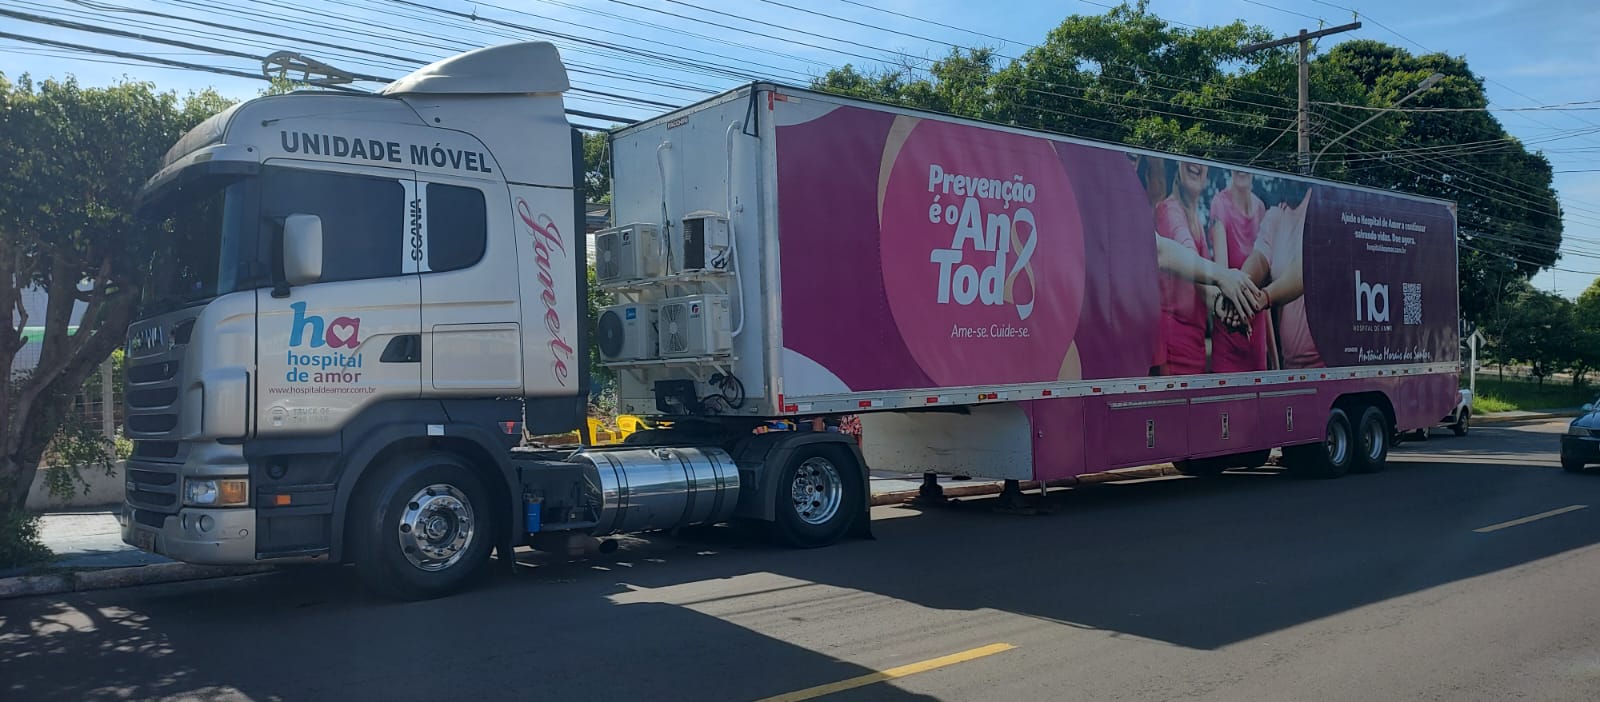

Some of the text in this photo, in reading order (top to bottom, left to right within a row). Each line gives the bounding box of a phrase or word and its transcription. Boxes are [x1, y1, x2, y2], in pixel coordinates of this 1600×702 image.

[281, 131, 492, 173] UNIDADE MÓVEL
[928, 164, 1036, 209] Prevenção
[929, 194, 942, 223] é
[945, 204, 958, 224] o
[410, 199, 423, 262] SCANIA
[1341, 212, 1356, 224] Ajude
[1361, 215, 1381, 227] Hospital
[1382, 217, 1388, 227] de
[1389, 219, 1401, 229] Amor
[1405, 222, 1426, 232] continuar
[1354, 229, 1377, 240] salvando
[516, 197, 573, 387] Janete
[1355, 270, 1389, 322] ha
[289, 301, 361, 349] ha
[951, 324, 1030, 338] Ame-se. Cuide-se.
[287, 350, 362, 370] hospital
[1404, 346, 1412, 360] dos
[1414, 345, 1430, 360] Santos
[286, 367, 361, 383] de amor
[269, 386, 376, 395] www.hospitaldeamor.com.br
